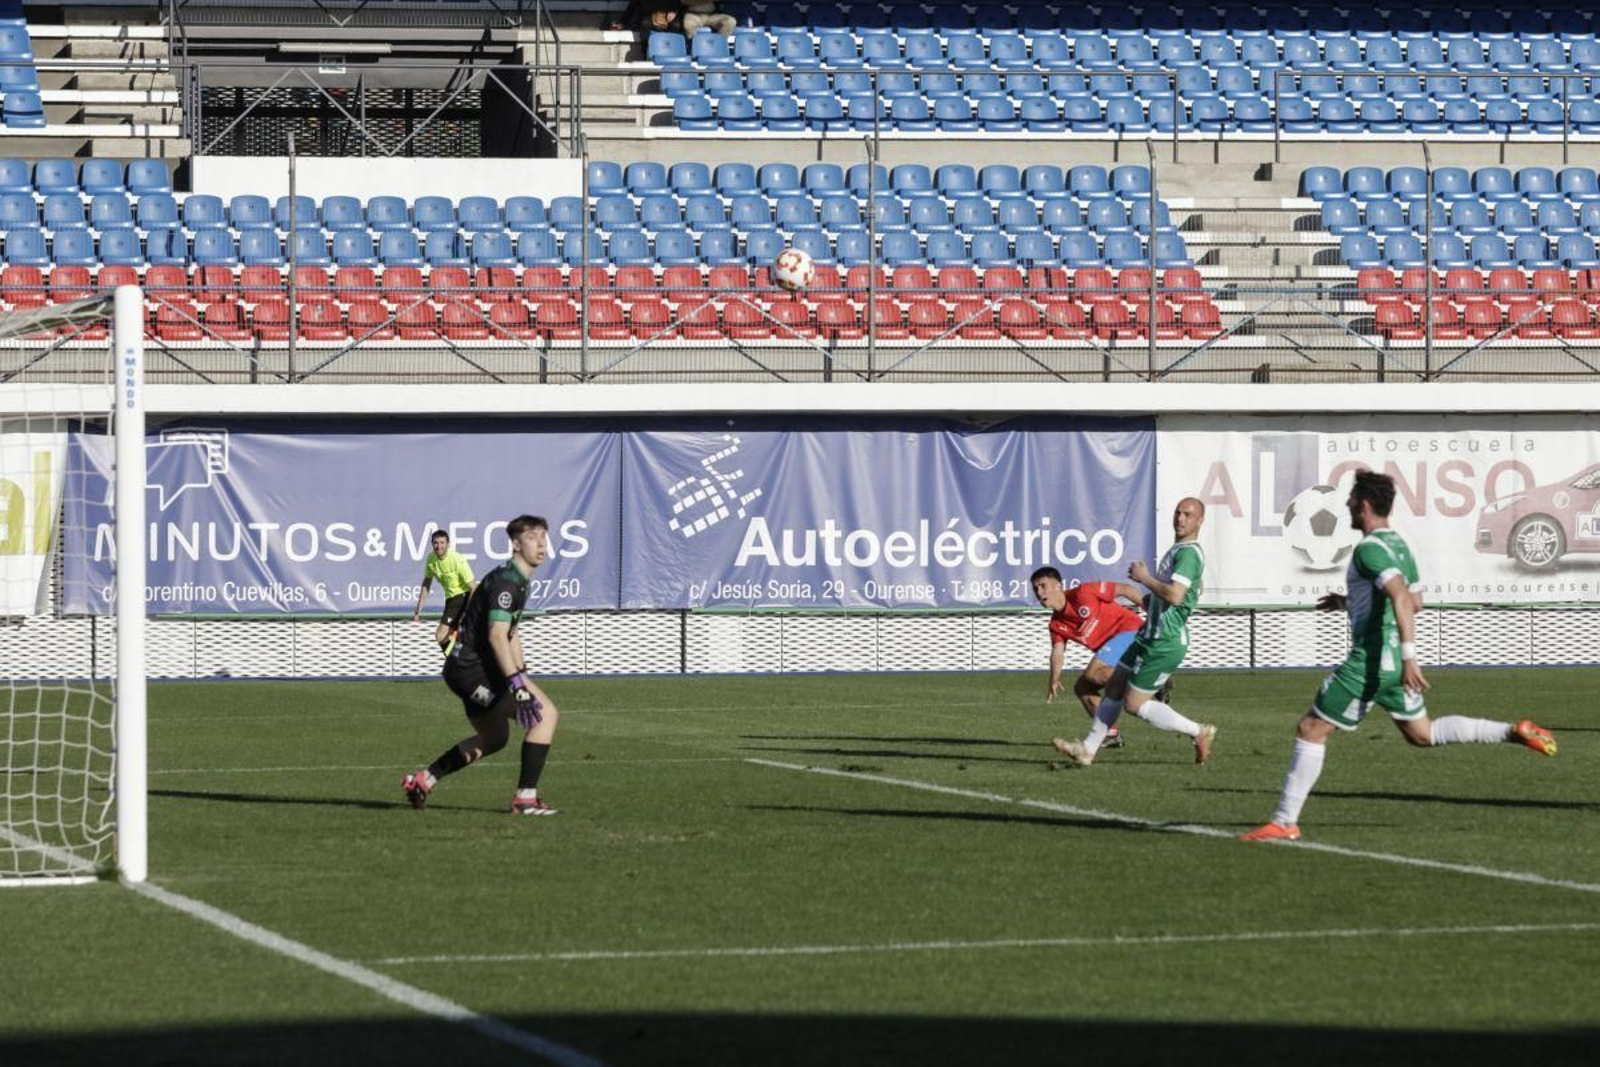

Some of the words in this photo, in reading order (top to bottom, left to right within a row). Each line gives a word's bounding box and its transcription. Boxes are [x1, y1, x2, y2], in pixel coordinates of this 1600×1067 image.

[125, 357, 136, 408] MONDO
[1327, 432, 1537, 453] autoescuela
[734, 515, 1124, 567] Autoeléctrico
[223, 581, 309, 604] Cuevillas,
[315, 582, 327, 601] 6
[347, 581, 422, 602] Ourense
[530, 580, 552, 599] 27
[558, 578, 580, 598] 50
[690, 580, 707, 599] c/
[712, 580, 762, 600] Jesús
[768, 579, 816, 602] Soria,
[822, 580, 845, 599] 29
[864, 580, 935, 600] Ourense
[970, 580, 1003, 599] 988
[1008, 580, 1029, 599] 21
